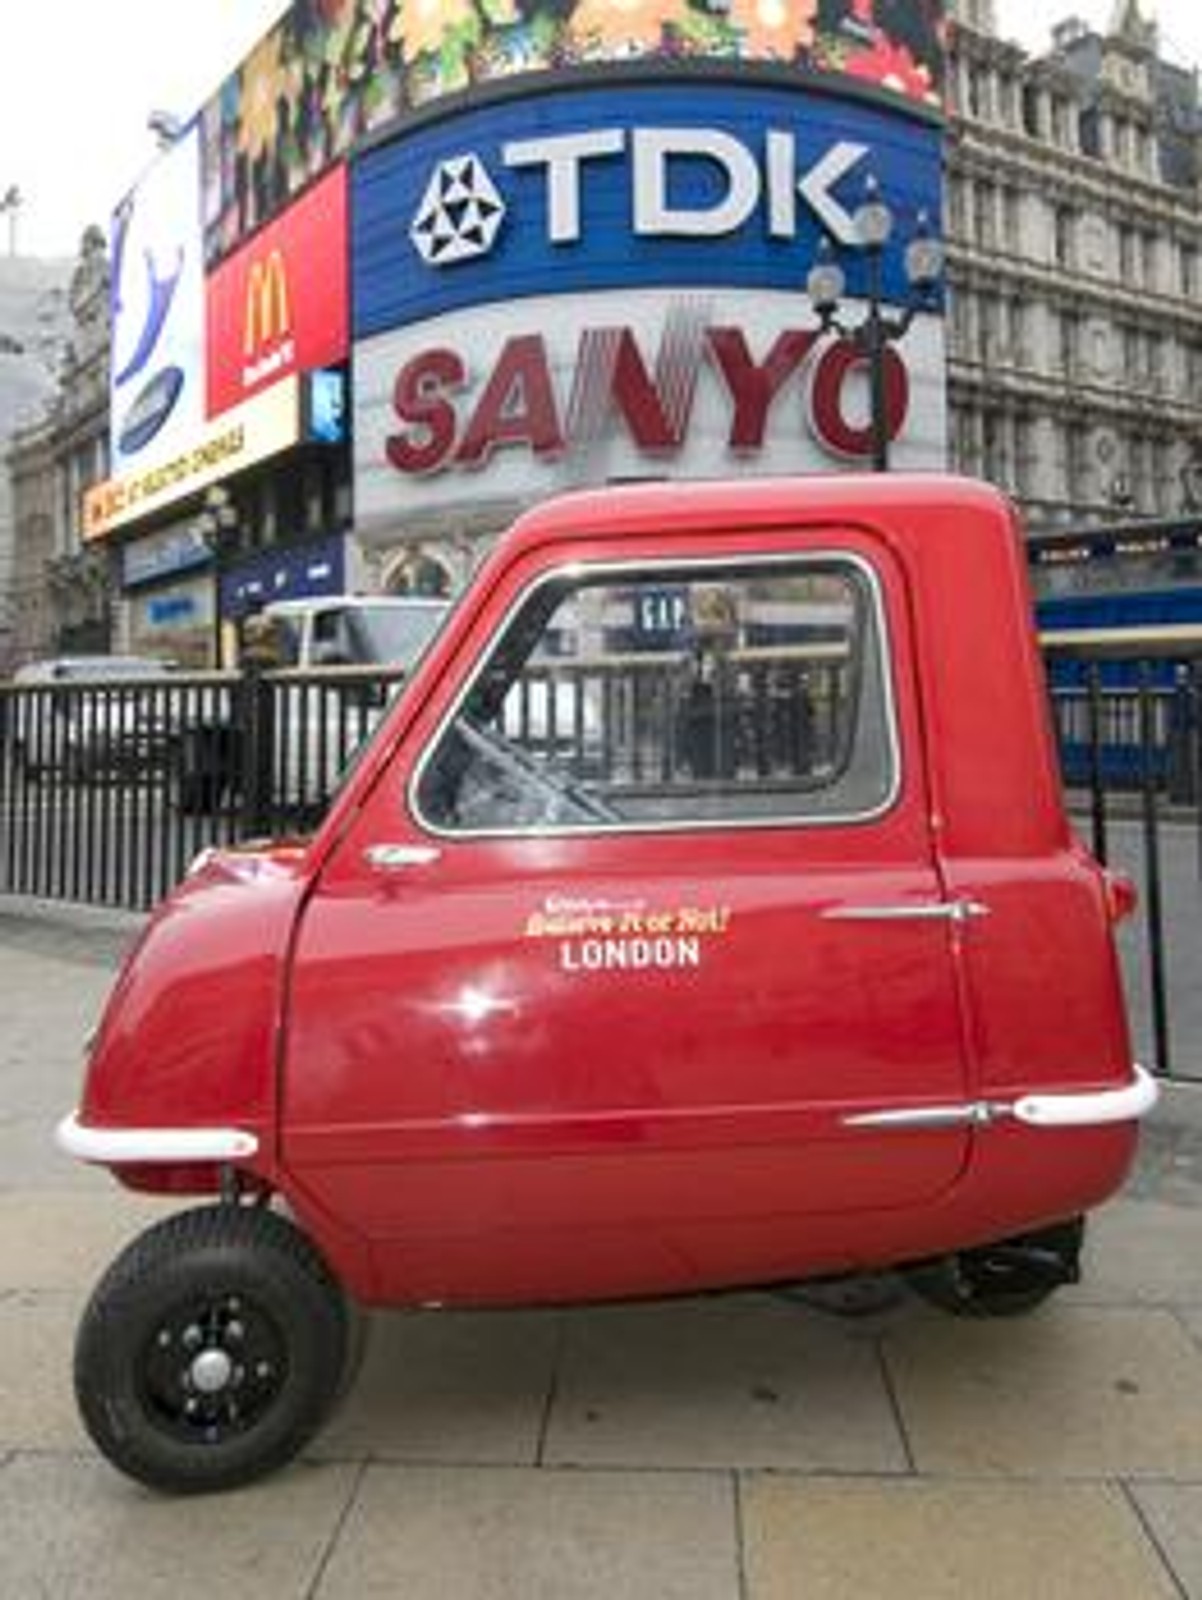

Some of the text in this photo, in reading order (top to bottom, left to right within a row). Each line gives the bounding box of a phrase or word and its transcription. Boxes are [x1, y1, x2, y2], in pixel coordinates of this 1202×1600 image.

[503, 127, 869, 245] TDK
[384, 300, 910, 474] SANYO
[560, 936, 700, 970] LONDON
